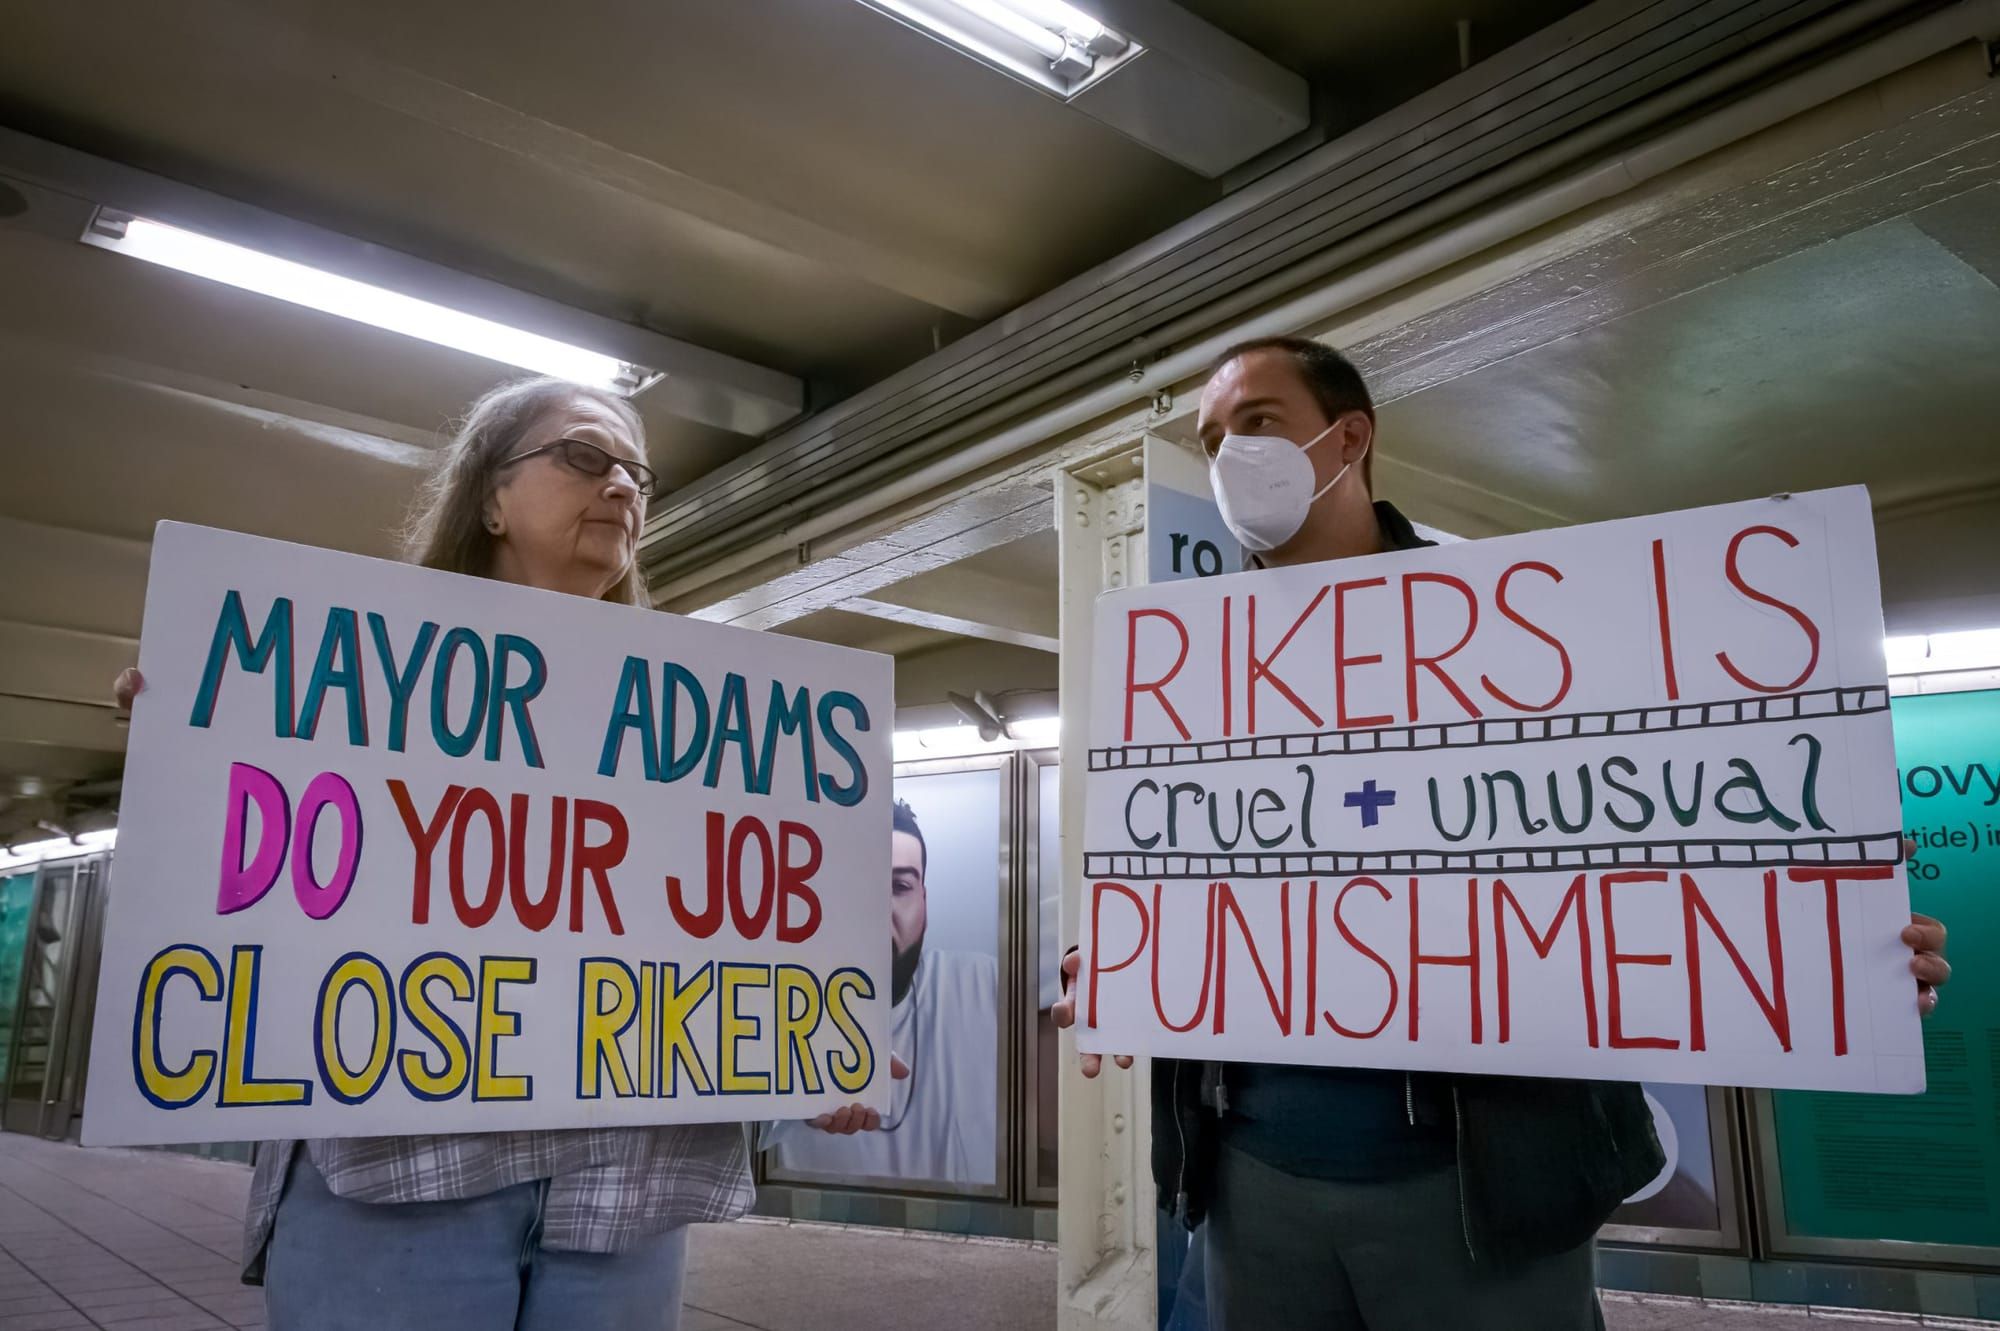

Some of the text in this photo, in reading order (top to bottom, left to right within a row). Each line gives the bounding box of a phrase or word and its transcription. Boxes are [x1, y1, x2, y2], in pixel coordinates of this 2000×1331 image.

[189, 590, 870, 808] MAYOR ADAMS
[1124, 525, 1820, 743] RIKERS IS
[217, 761, 824, 944] DO YOUR JOB
[1124, 765, 1316, 852] cruel
[1427, 733, 1837, 843] unusual
[132, 943, 876, 1110] CLOSE RIKERS
[1086, 866, 1895, 1056] PUNISHMENT
